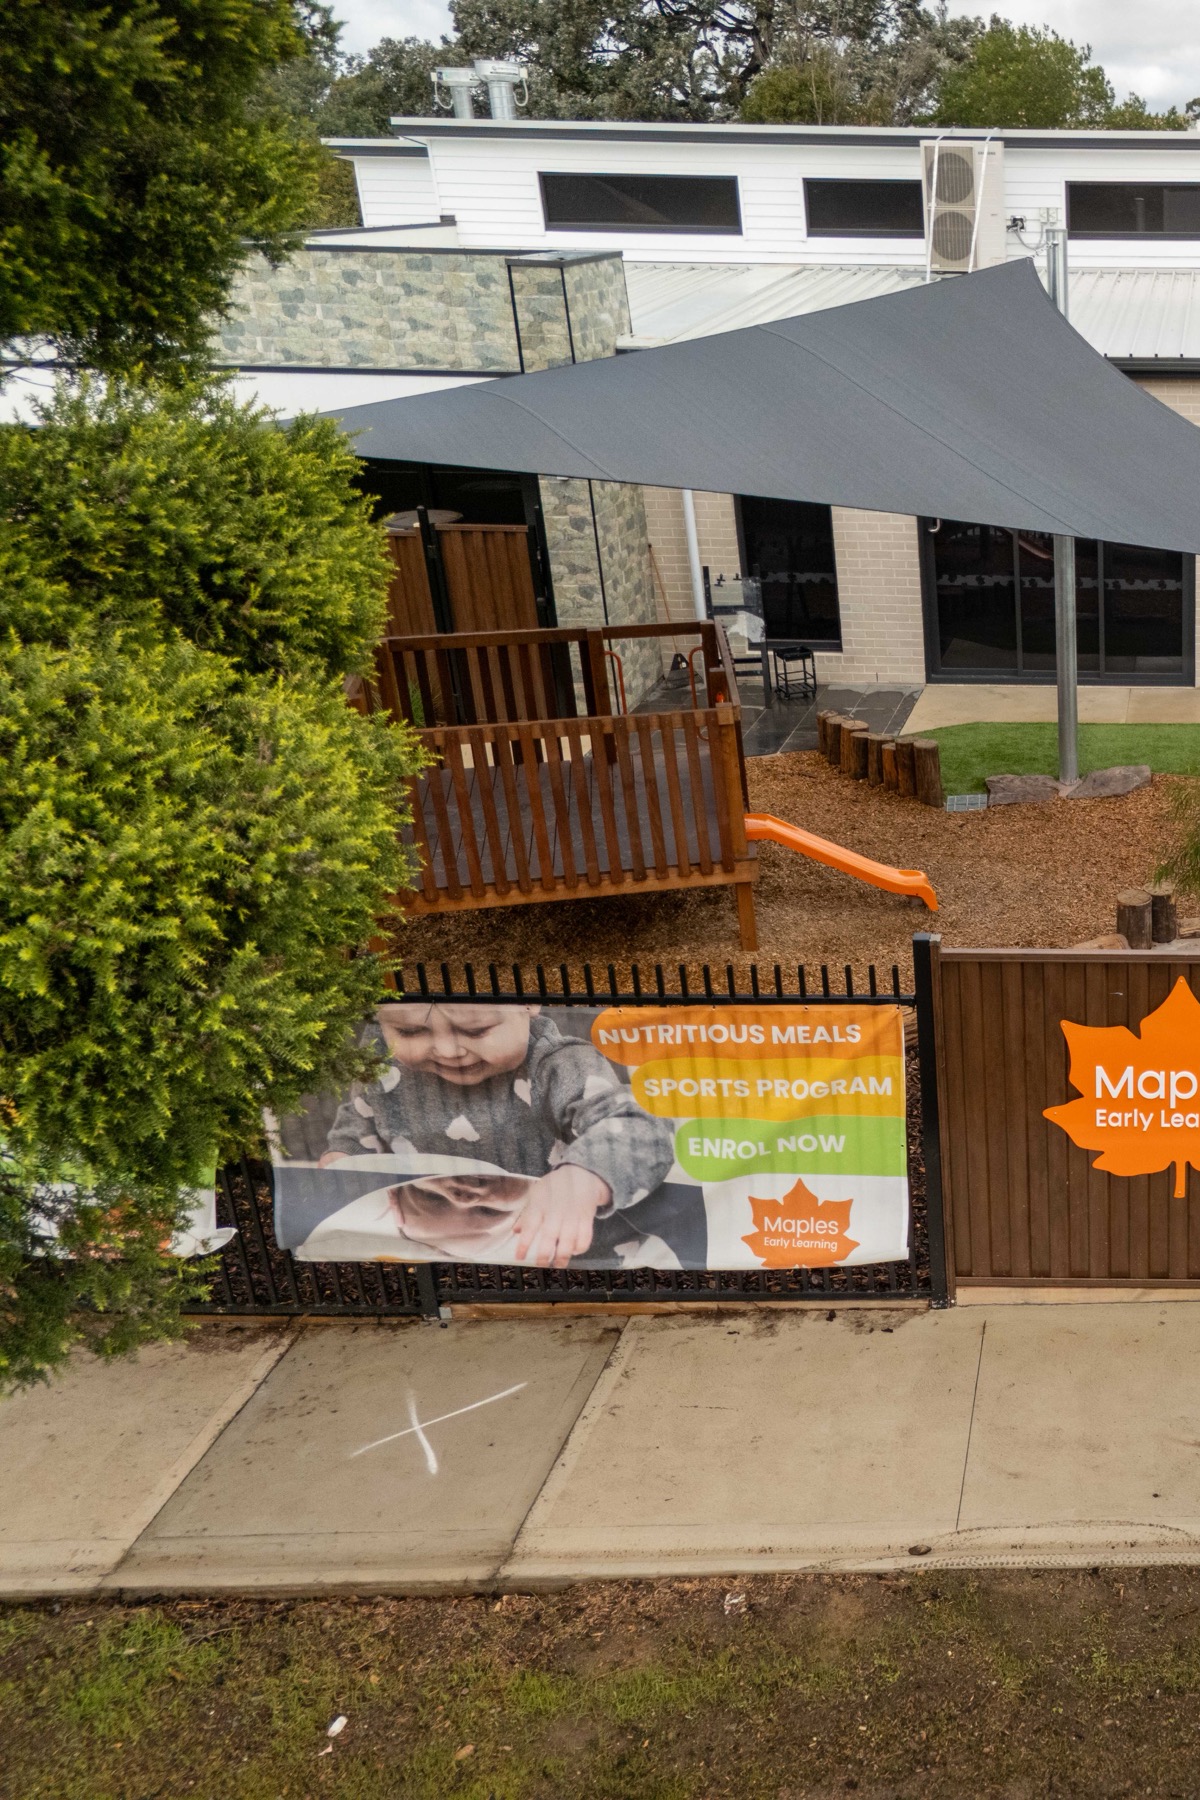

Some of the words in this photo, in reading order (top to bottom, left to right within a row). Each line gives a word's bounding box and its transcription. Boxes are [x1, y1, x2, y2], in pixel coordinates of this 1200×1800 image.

[599, 1024, 764, 1045] NUTRITIOUS
[772, 1024, 861, 1044] MEALS
[644, 1079, 750, 1098] SPORTS
[757, 1077, 892, 1100] PROGRAM
[1095, 1108, 1154, 1131] Early
[688, 1137, 771, 1160] ENROL
[777, 1134, 846, 1153] NOW
[763, 1216, 839, 1238] Maples
[764, 1237, 789, 1249] Early
[792, 1238, 838, 1253] Learning
